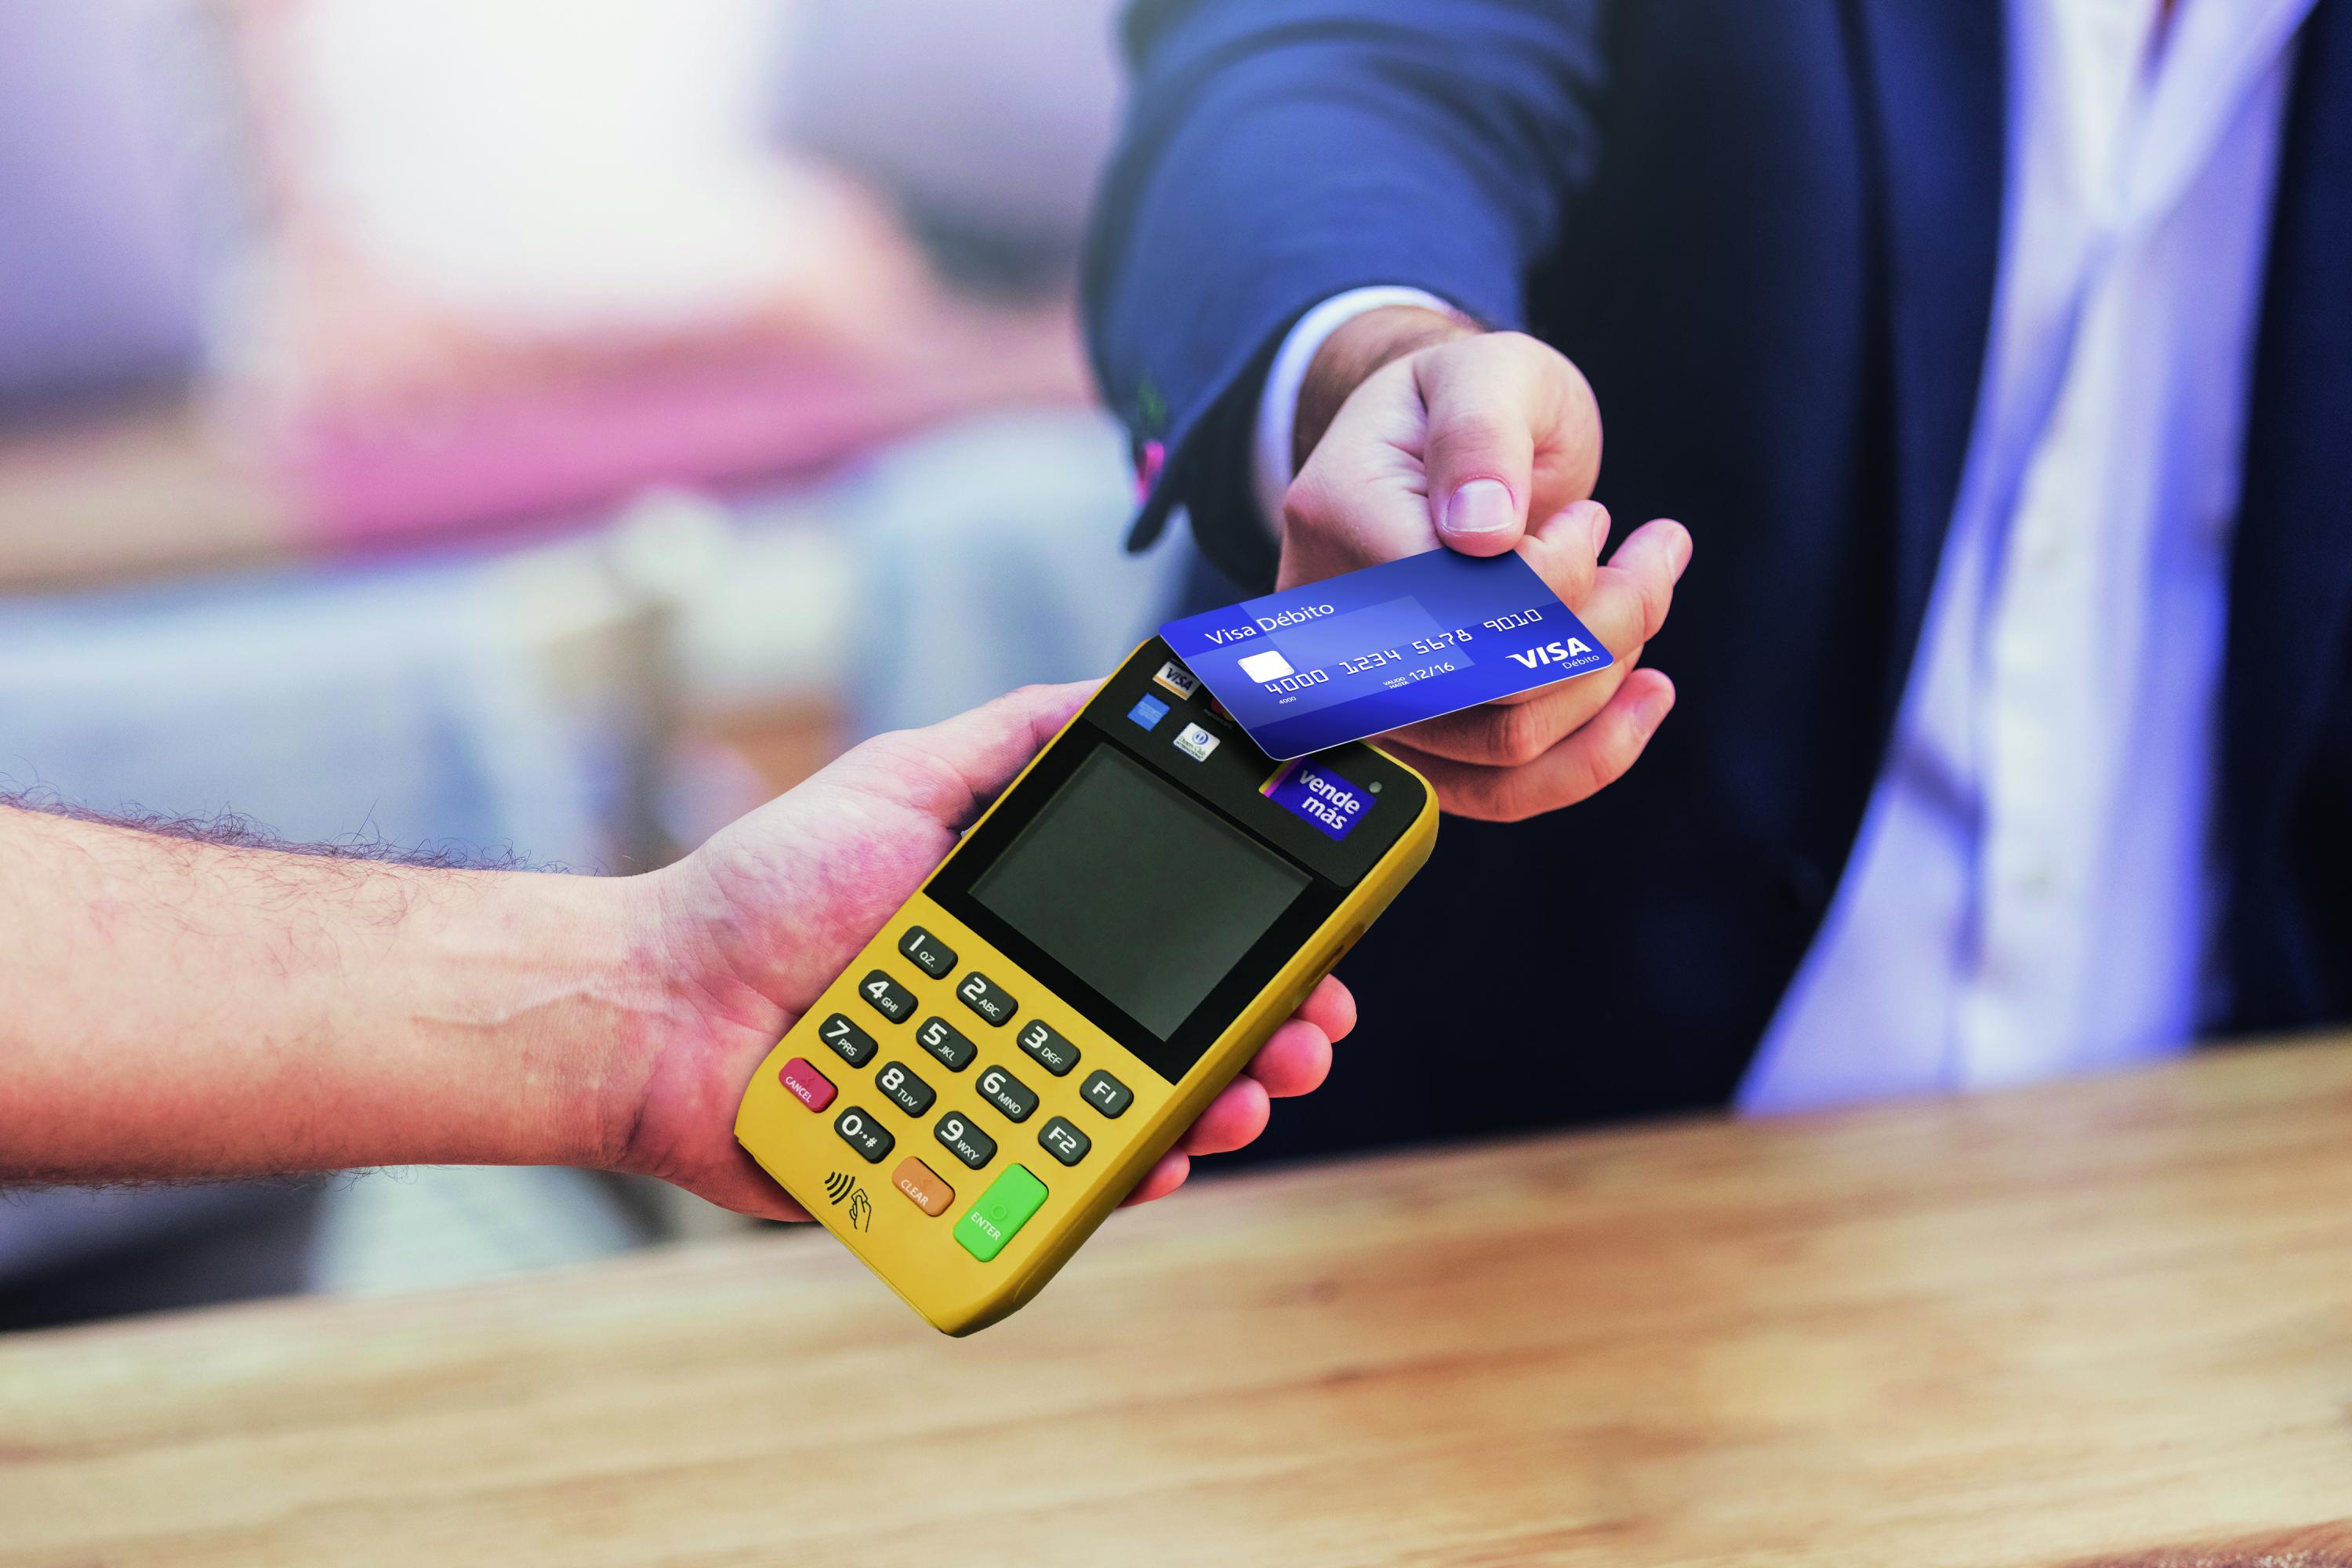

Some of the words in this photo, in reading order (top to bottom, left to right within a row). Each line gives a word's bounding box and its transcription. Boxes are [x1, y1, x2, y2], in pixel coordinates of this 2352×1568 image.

[1204, 625, 1258, 644] Visa
[1256, 604, 1334, 632] Débito
[1265, 670, 1330, 695] 4000
[1338, 649, 1403, 675] 1234
[1412, 629, 1472, 655] 5678
[1483, 608, 1543, 632] 9010
[1505, 637, 1592, 669] VISA
[1563, 654, 1600, 670] Débito
[1166, 667, 1194, 691] VISA
[1383, 677, 1406, 686] VALIDO
[1388, 681, 1410, 689] HASTA
[1409, 662, 1455, 681] 12/16
[1300, 770, 1360, 815] vende
[1301, 797, 1348, 829] más
[867, 980, 890, 1000] 4
[881, 996, 898, 1013] GHI
[962, 976, 987, 1001] 2
[978, 999, 1000, 1017] ABC
[826, 1019, 851, 1038] 7
[923, 1022, 948, 1046] 5
[938, 1045, 956, 1062] JKL
[837, 1038, 858, 1057] PRS
[1024, 1025, 1048, 1049] 3
[1041, 1047, 1063, 1065] DEF
[785, 1076, 812, 1104] CANCEL
[881, 1067, 905, 1091] 8
[896, 1088, 917, 1107] TUV
[983, 1072, 1007, 1094] 6
[997, 1092, 1022, 1114] MNO
[1091, 1080, 1117, 1104] F1
[941, 1119, 964, 1142] 9
[956, 1139, 980, 1161] WXY
[1047, 1126, 1077, 1154] F2
[901, 1178, 929, 1206] CLEAR
[970, 1211, 1002, 1241] ENTER
